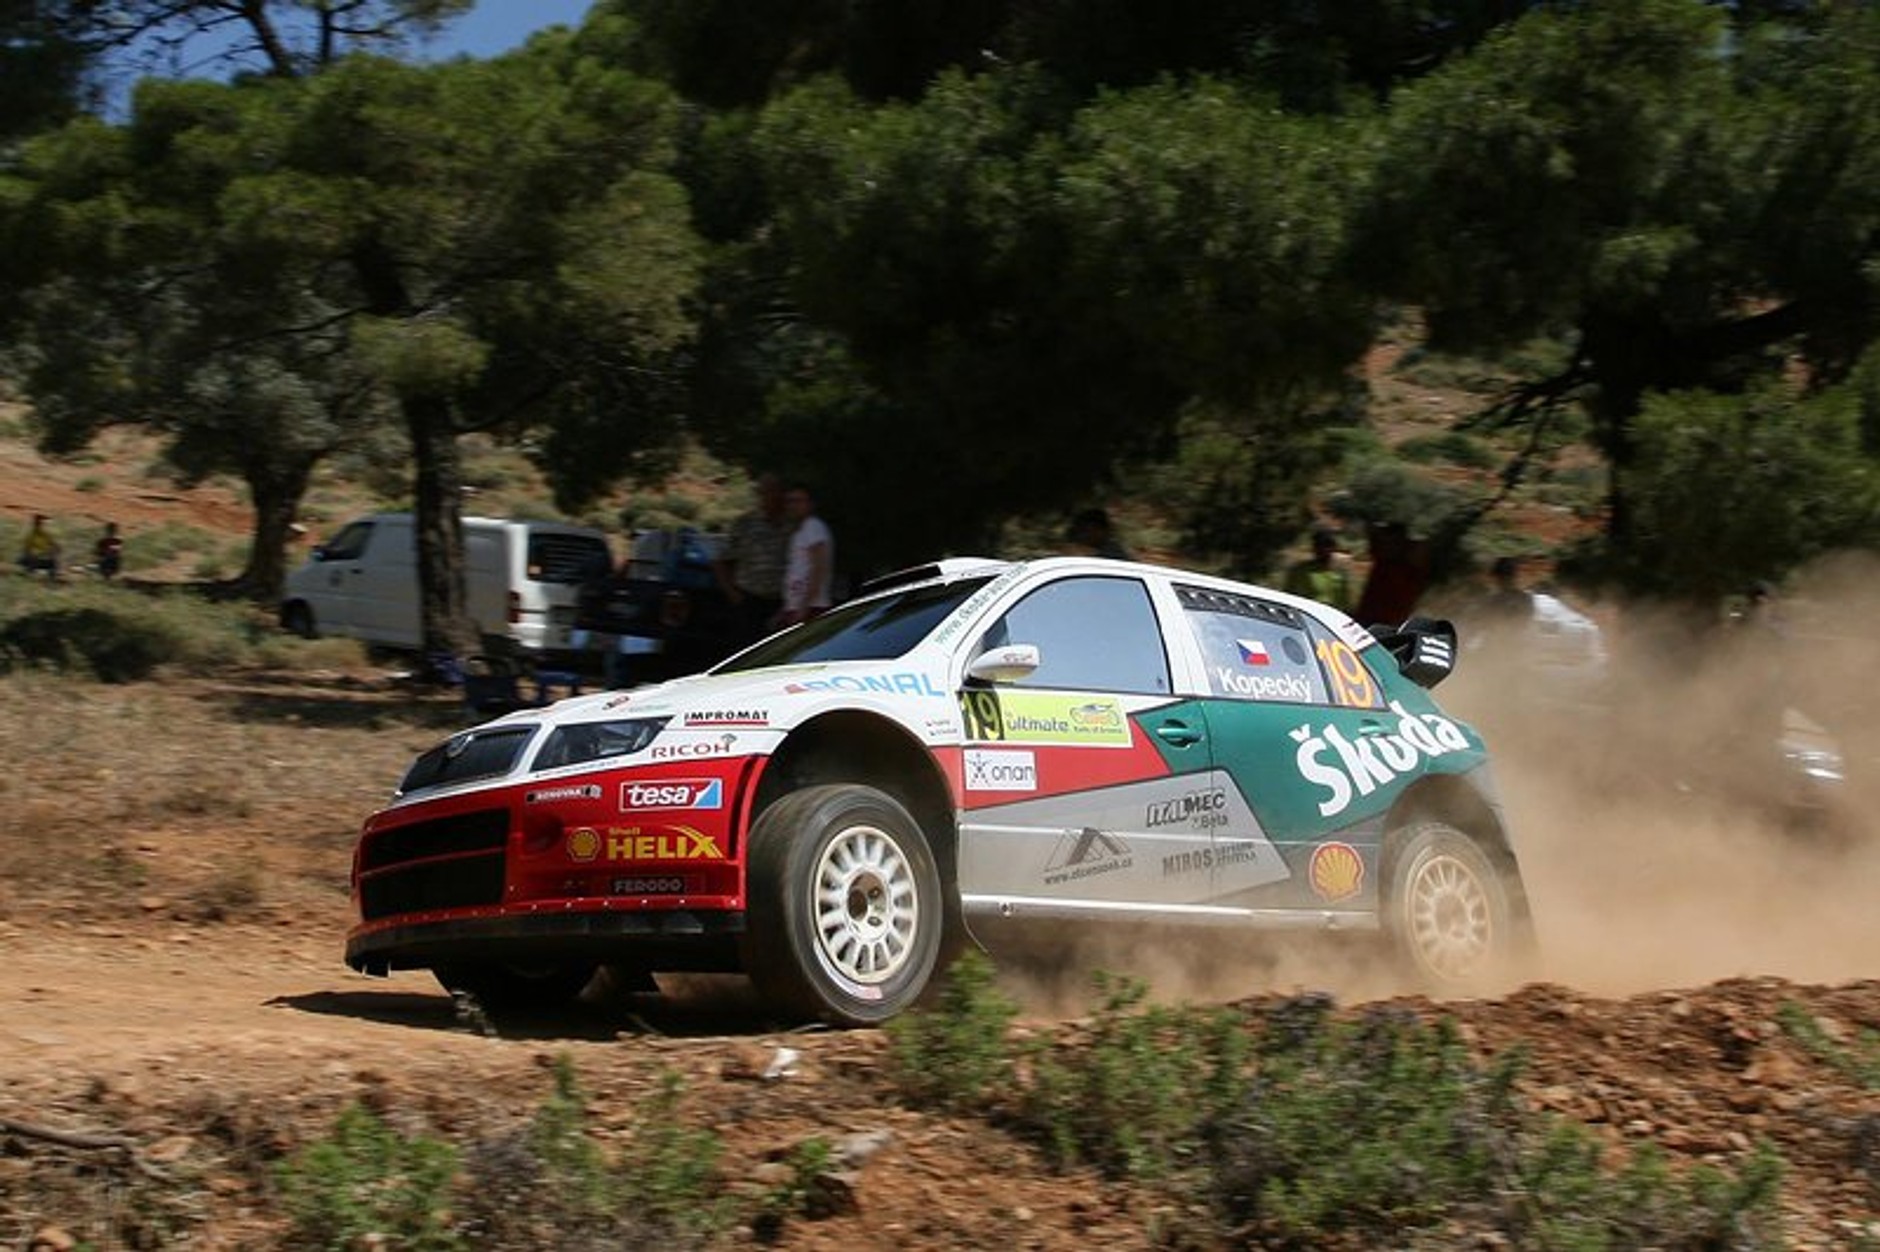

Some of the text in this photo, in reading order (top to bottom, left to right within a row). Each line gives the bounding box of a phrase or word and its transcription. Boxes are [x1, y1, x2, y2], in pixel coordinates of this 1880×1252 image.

[1316, 638, 1375, 707] 19
[1217, 667, 1312, 703] Kopecký
[684, 710, 769, 721] IMPROMAT
[961, 690, 1001, 740] 19
[651, 742, 731, 758] RICOH
[1289, 700, 1470, 816] Škoda
[627, 784, 690, 806] tesa
[607, 836, 724, 860] HELIX
[614, 878, 683, 893] FERODO
